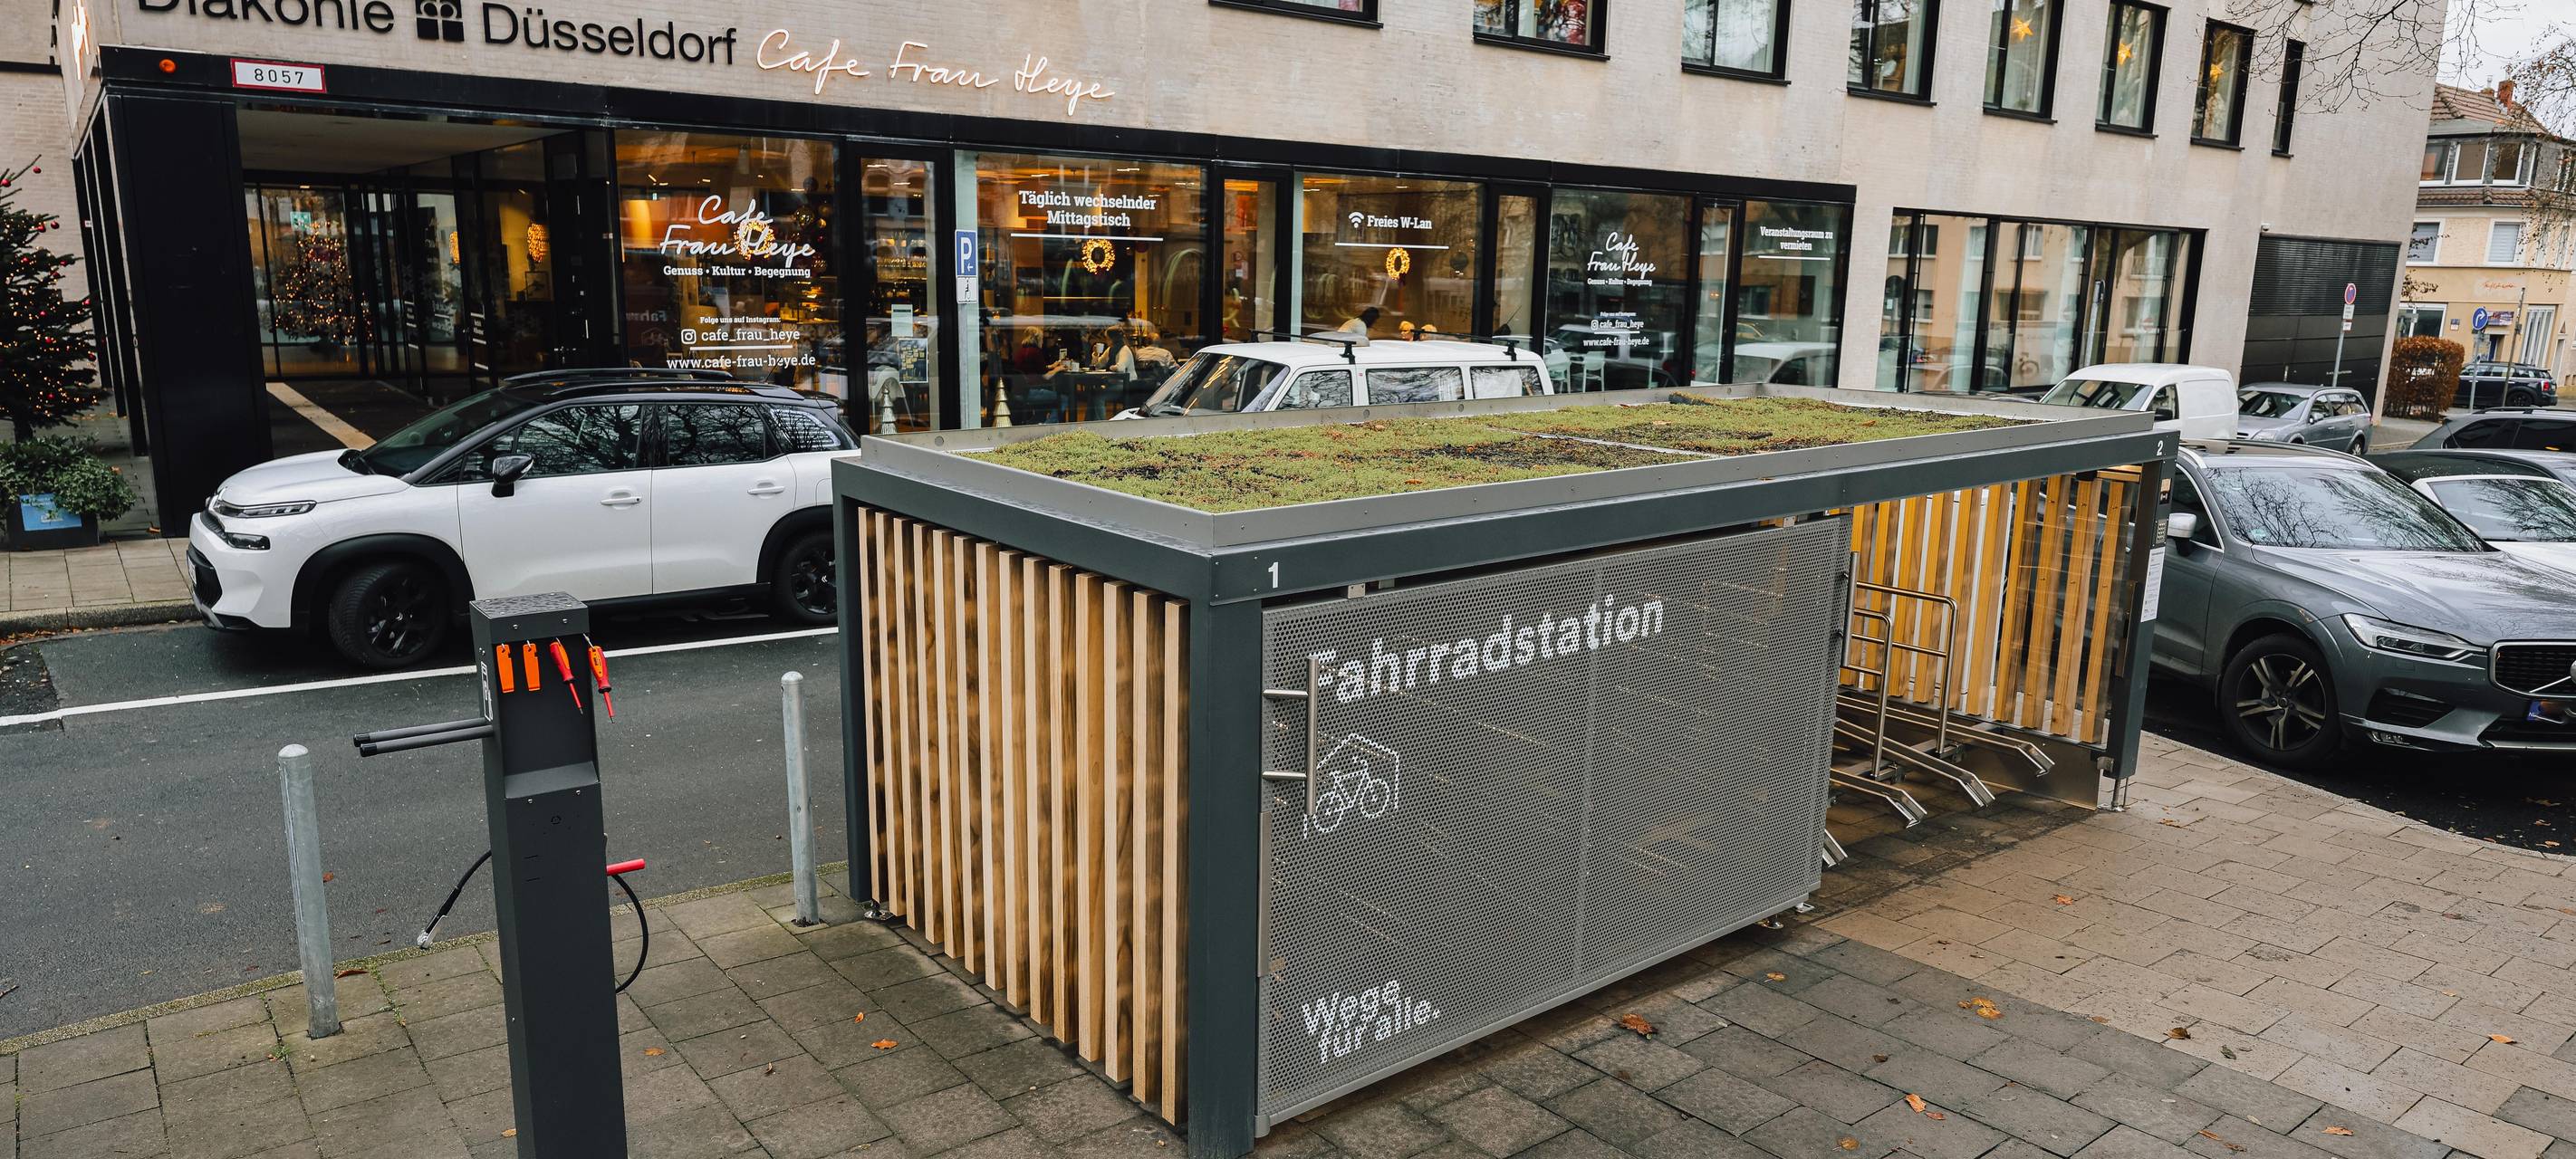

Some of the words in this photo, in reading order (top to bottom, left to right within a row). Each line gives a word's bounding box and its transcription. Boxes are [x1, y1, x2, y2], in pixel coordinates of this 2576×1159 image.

[139, 0, 395, 34] akonie
[482, 2, 736, 65] Düsseldorf
[254, 68, 304, 85] 8057
[756, 28, 870, 95] Cafe
[889, 41, 999, 89] Frau
[1014, 53, 1116, 116] Heye
[1018, 190, 1072, 208] Täglich
[1072, 193, 1157, 210] wechselnder
[697, 195, 774, 240] Cafe
[1046, 210, 1131, 228] Mittagstisch
[1367, 215, 1399, 228] Freies
[1400, 216, 1433, 229] W-Lan
[659, 224, 736, 255] Frau
[738, 226, 816, 268] Heye
[960, 236, 973, 274] P
[1605, 231, 1639, 261] Cafe
[1780, 240, 1812, 251] vermieten
[663, 265, 704, 276] Genuss
[711, 265, 746, 276] Kultur
[754, 266, 812, 278] Begegnung
[1587, 251, 1621, 272] Frau
[1621, 252, 1657, 280] Heye
[701, 329, 801, 342] cafe_frau_heye
[667, 354, 816, 369] www.cafe-frau-heye.de
[2156, 440, 2164, 456] 2
[1268, 561, 1279, 589] 1
[1308, 593, 1665, 704] Fahrradstation
[1302, 980, 1400, 1036] Wege
[1318, 1020, 1368, 1064] für
[1374, 996, 1441, 1041] alle.
